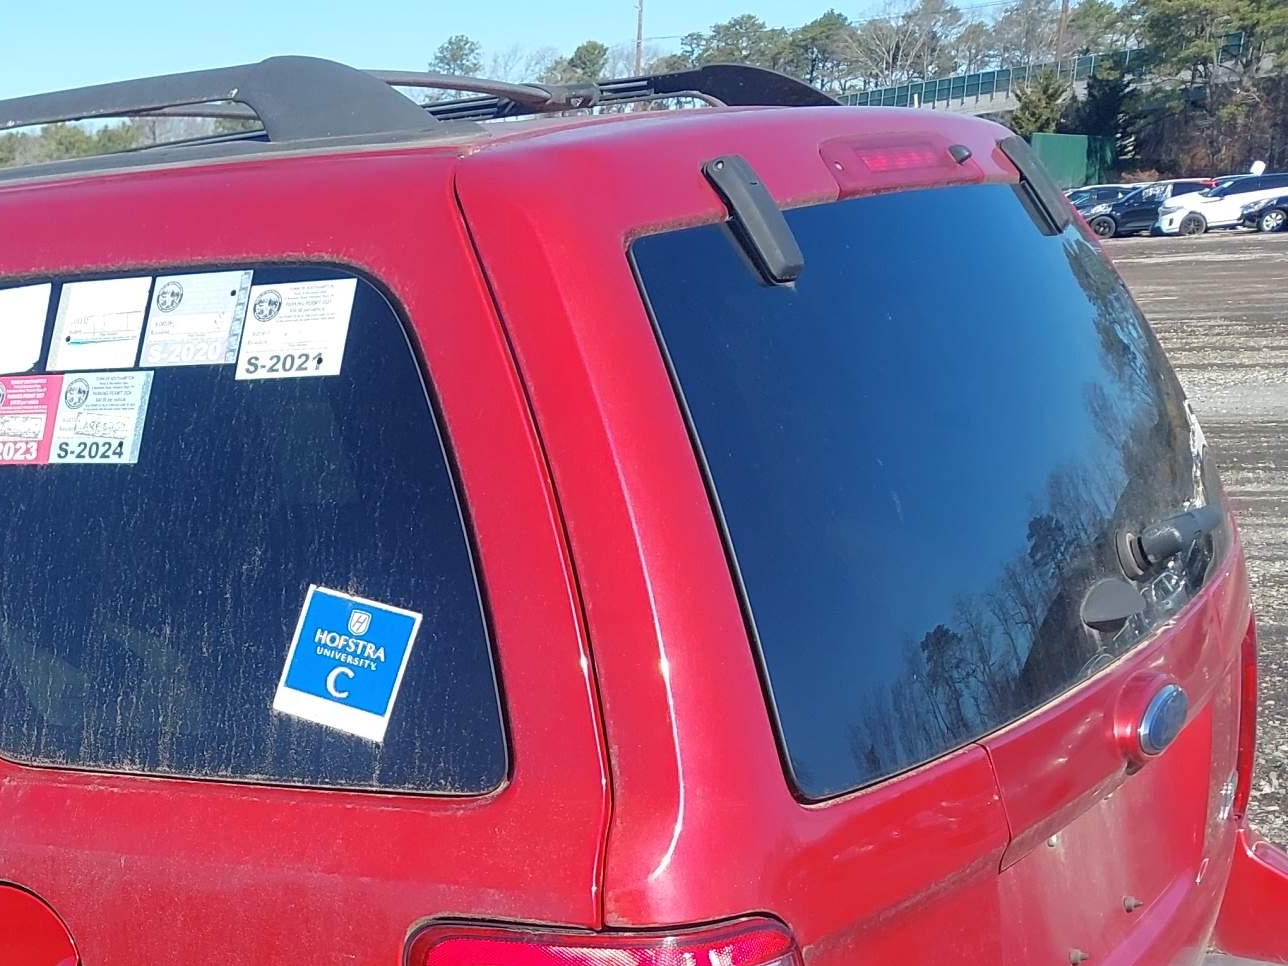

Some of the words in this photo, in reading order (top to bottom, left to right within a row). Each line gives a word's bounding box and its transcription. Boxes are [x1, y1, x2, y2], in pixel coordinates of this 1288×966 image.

[245, 352, 324, 374] S-2021
[57, 441, 124, 459] S-2024
[314, 628, 386, 662] HOFSTRA
[316, 647, 377, 670] UNIVERSITY
[325, 666, 355, 699] C
